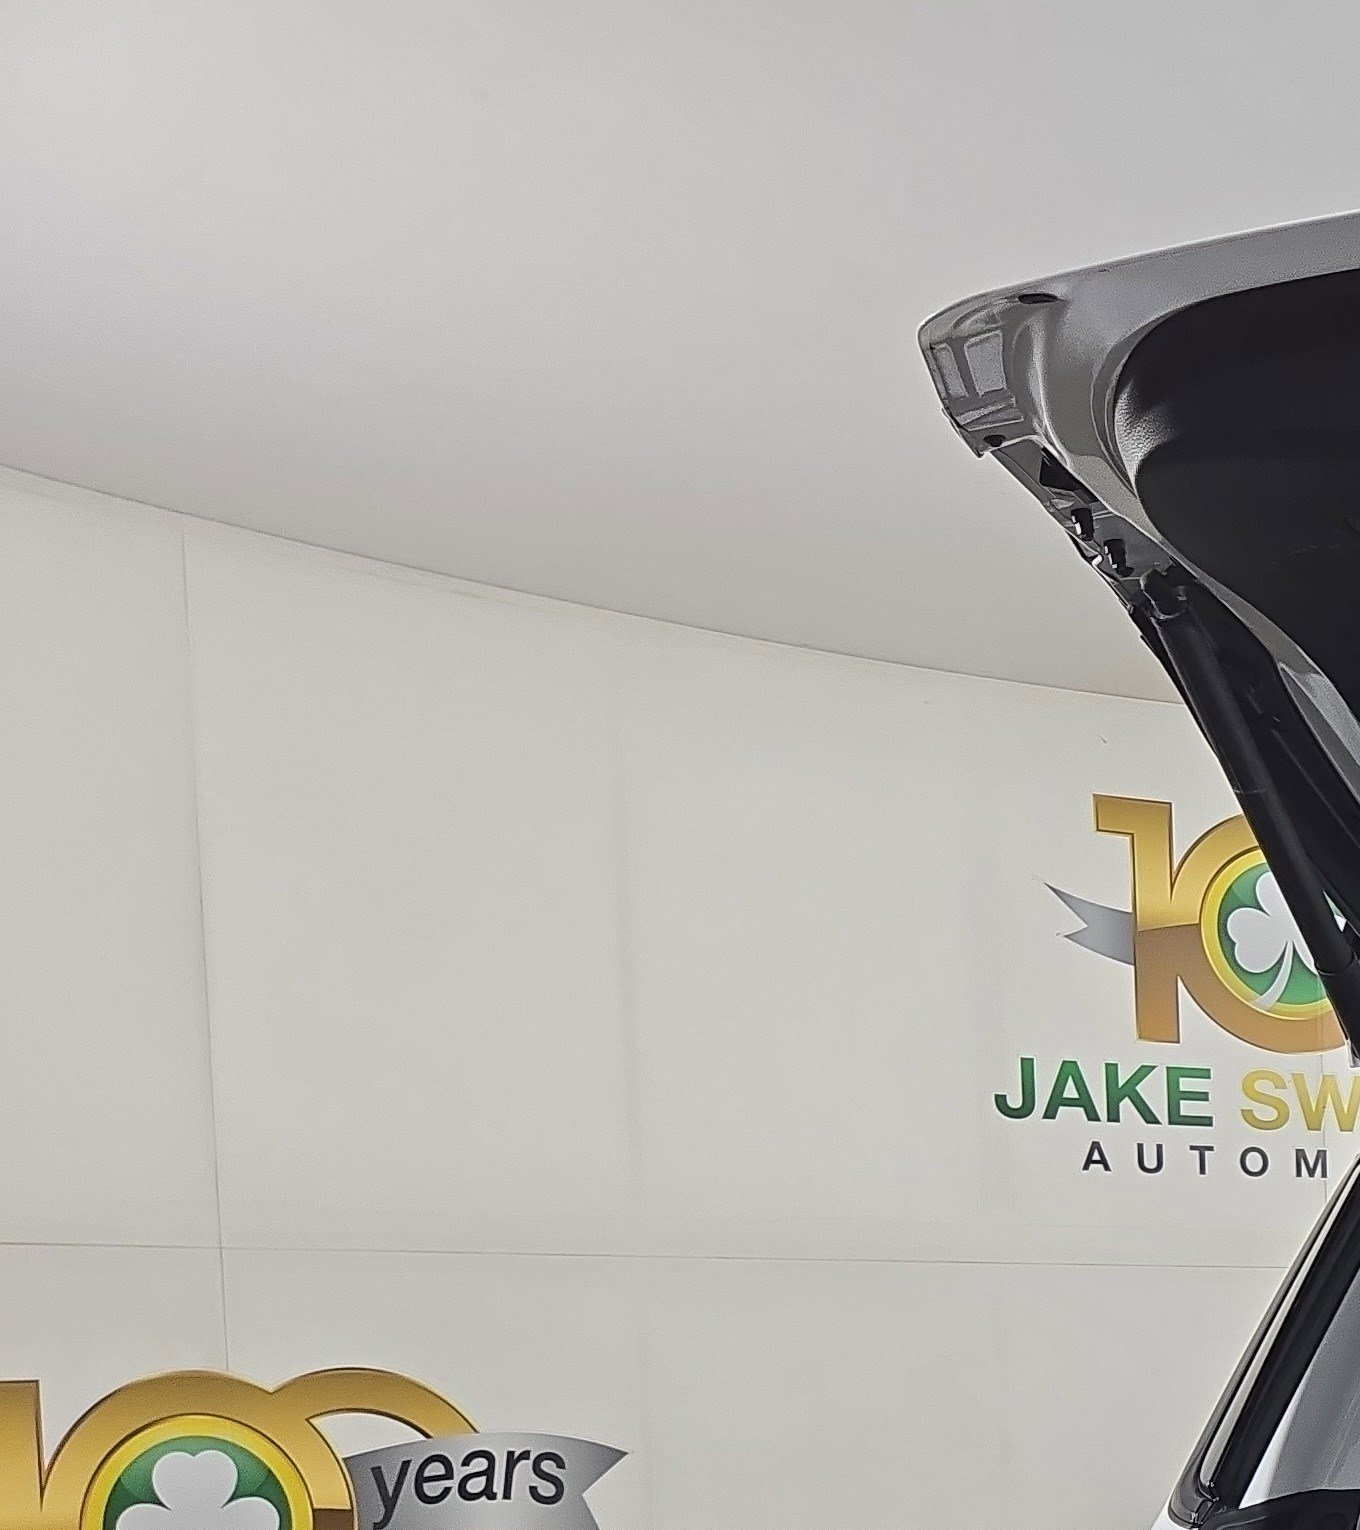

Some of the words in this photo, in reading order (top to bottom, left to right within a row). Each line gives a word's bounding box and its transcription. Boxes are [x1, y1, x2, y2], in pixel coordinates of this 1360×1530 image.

[993, 1056, 1214, 1128] JAKE
[1082, 1140, 1328, 1179] AUTOM
[371, 1448, 566, 1530] years
